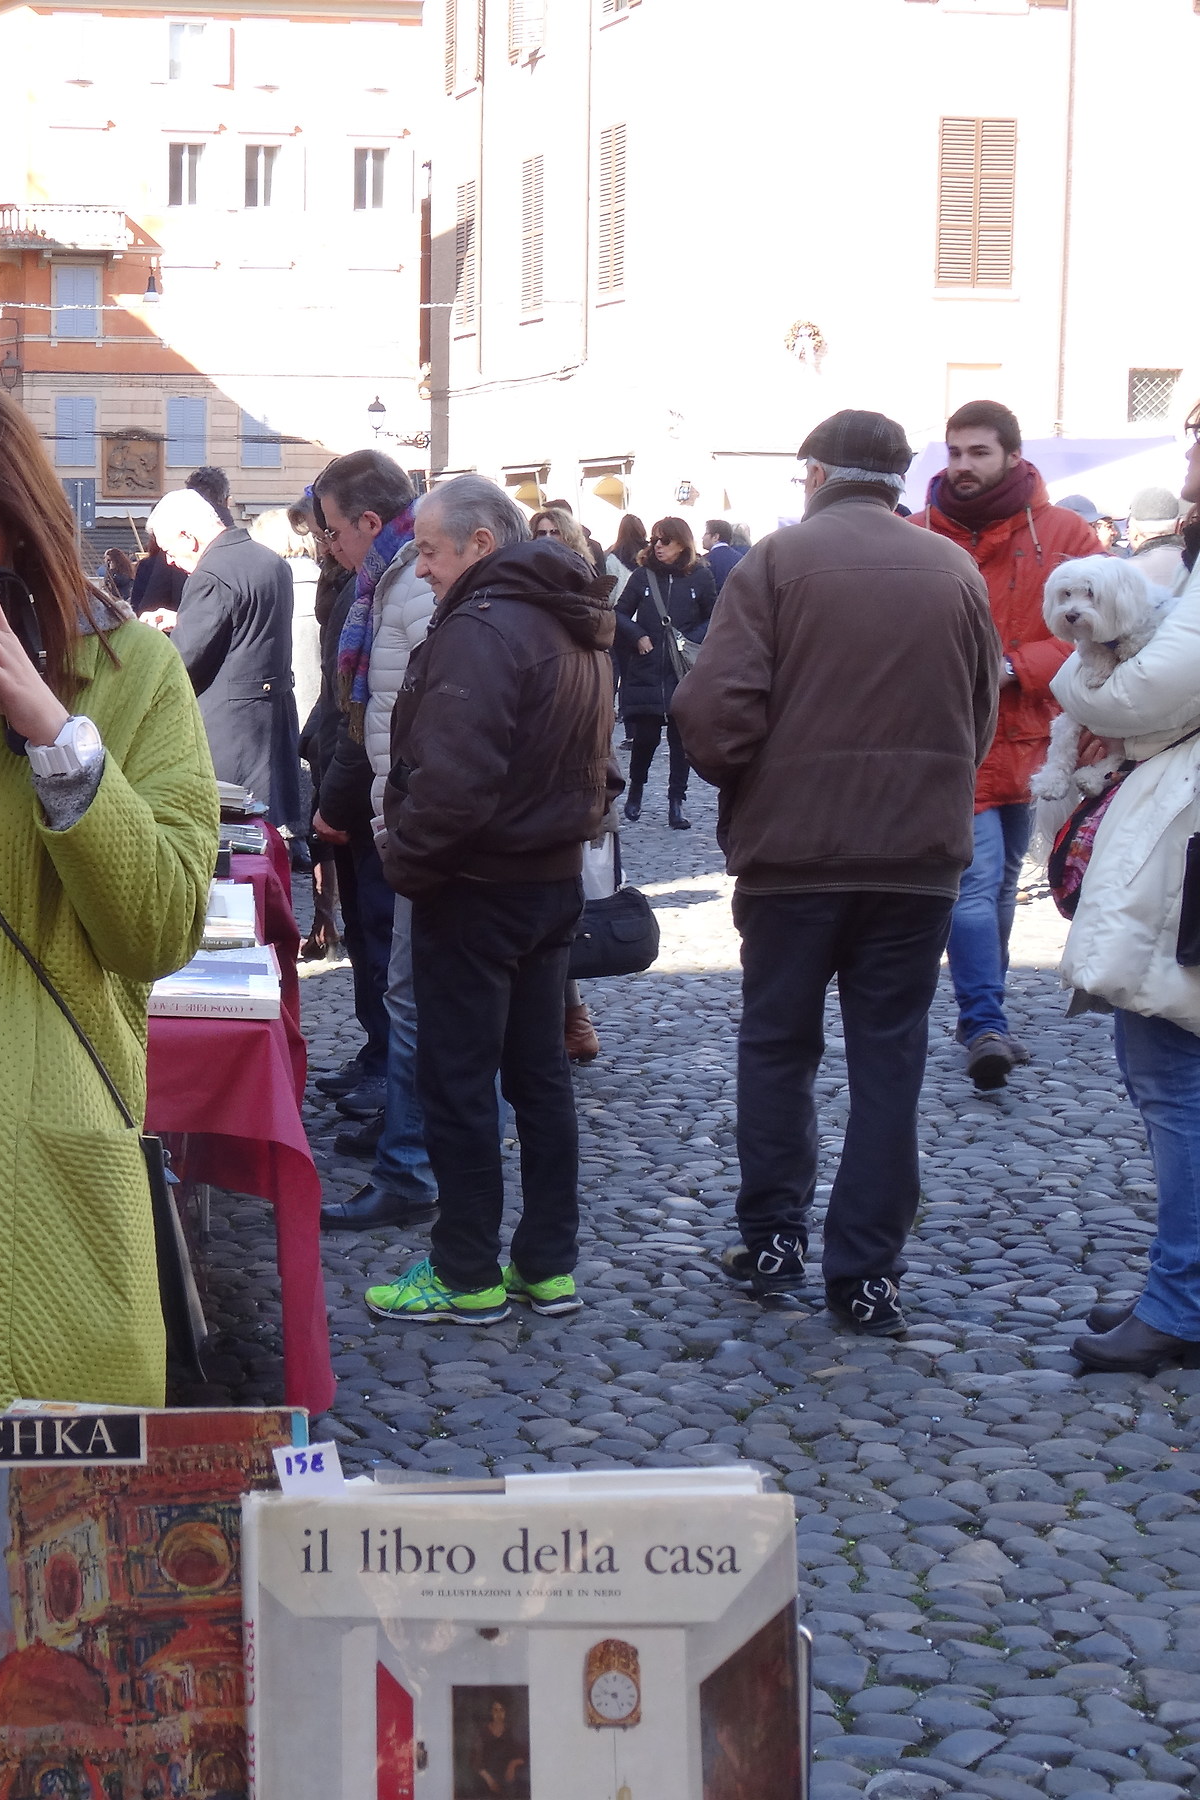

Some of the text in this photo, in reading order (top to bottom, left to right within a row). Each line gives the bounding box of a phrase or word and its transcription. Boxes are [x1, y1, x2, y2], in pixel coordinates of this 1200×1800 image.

[299, 1526, 742, 1576] il libro della casa
[438, 1588, 511, 1598] ILLUSTRAZIONI
[515, 1588, 523, 1598] A
[526, 1588, 562, 1598] COLORI
[567, 1588, 574, 1598] E
[578, 1588, 589, 1598] IN
[594, 1588, 622, 1598] NERO
